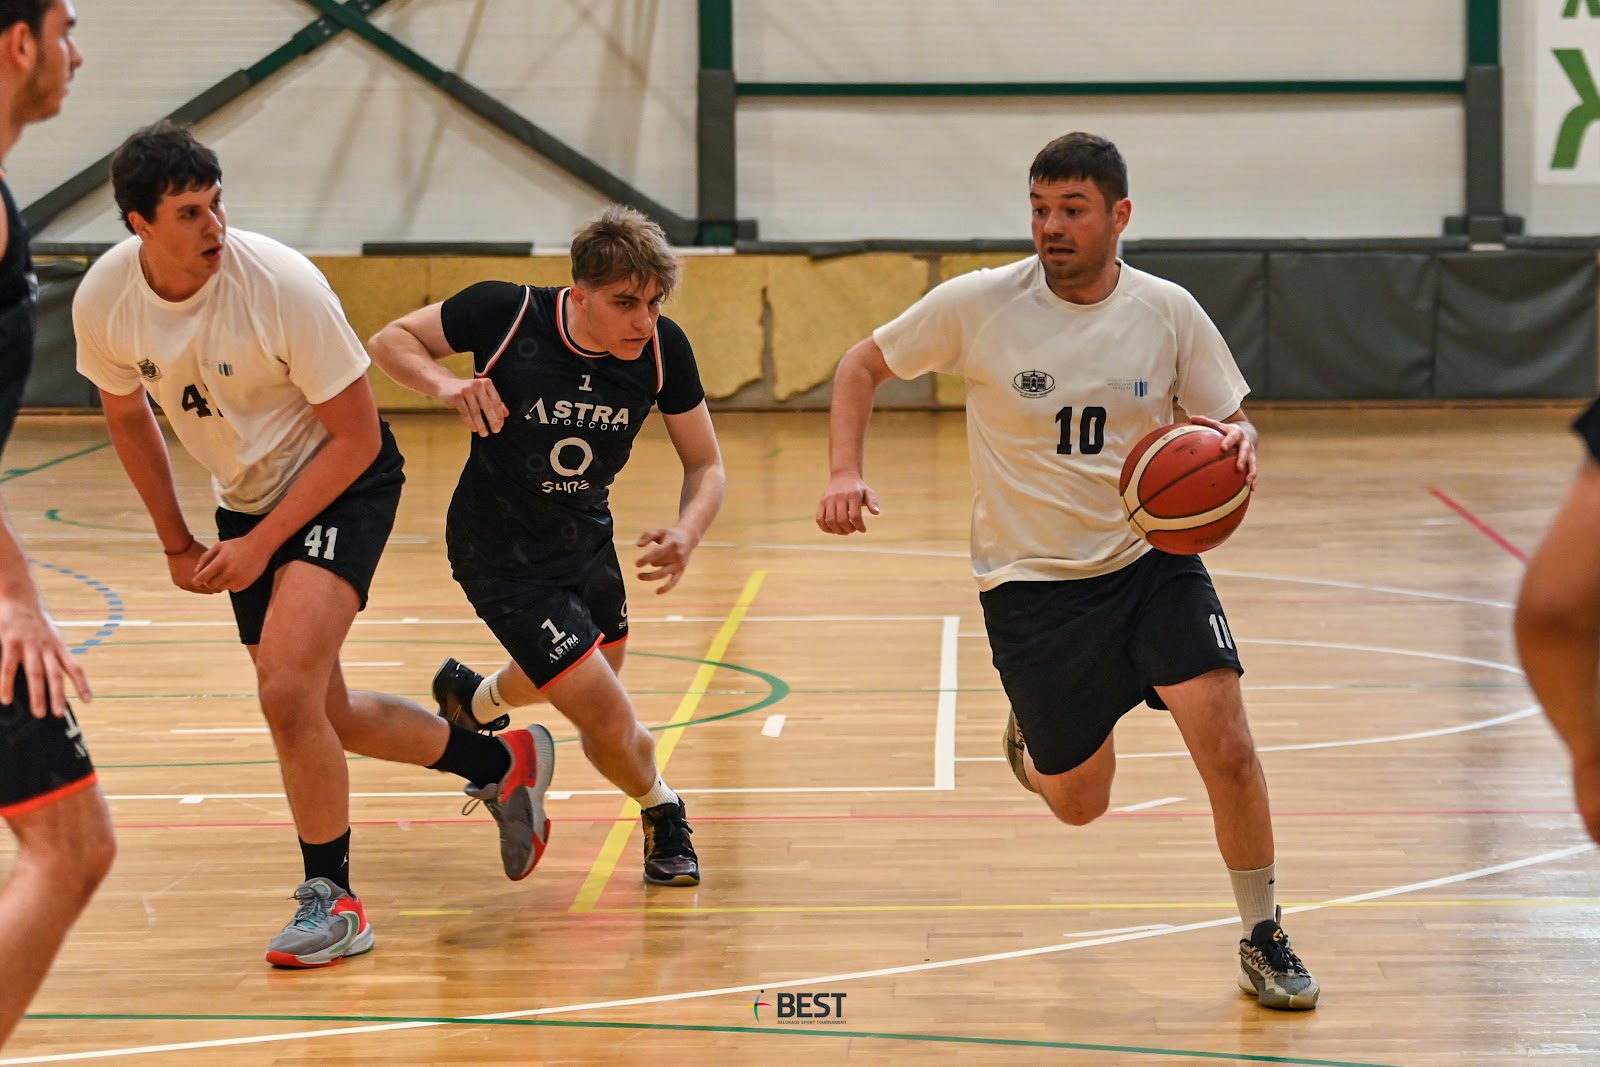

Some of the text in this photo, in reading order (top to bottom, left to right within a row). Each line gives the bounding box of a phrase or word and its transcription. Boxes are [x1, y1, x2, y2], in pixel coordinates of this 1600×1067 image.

[578, 374, 593, 392] 1
[181, 384, 224, 418] 4
[524, 397, 629, 425] ASTRA
[551, 418, 628, 431] BOCCONI
[1055, 406, 1107, 455] 10
[304, 525, 338, 561] 41
[541, 618, 566, 645] 1
[549, 633, 579, 664] ASTRA
